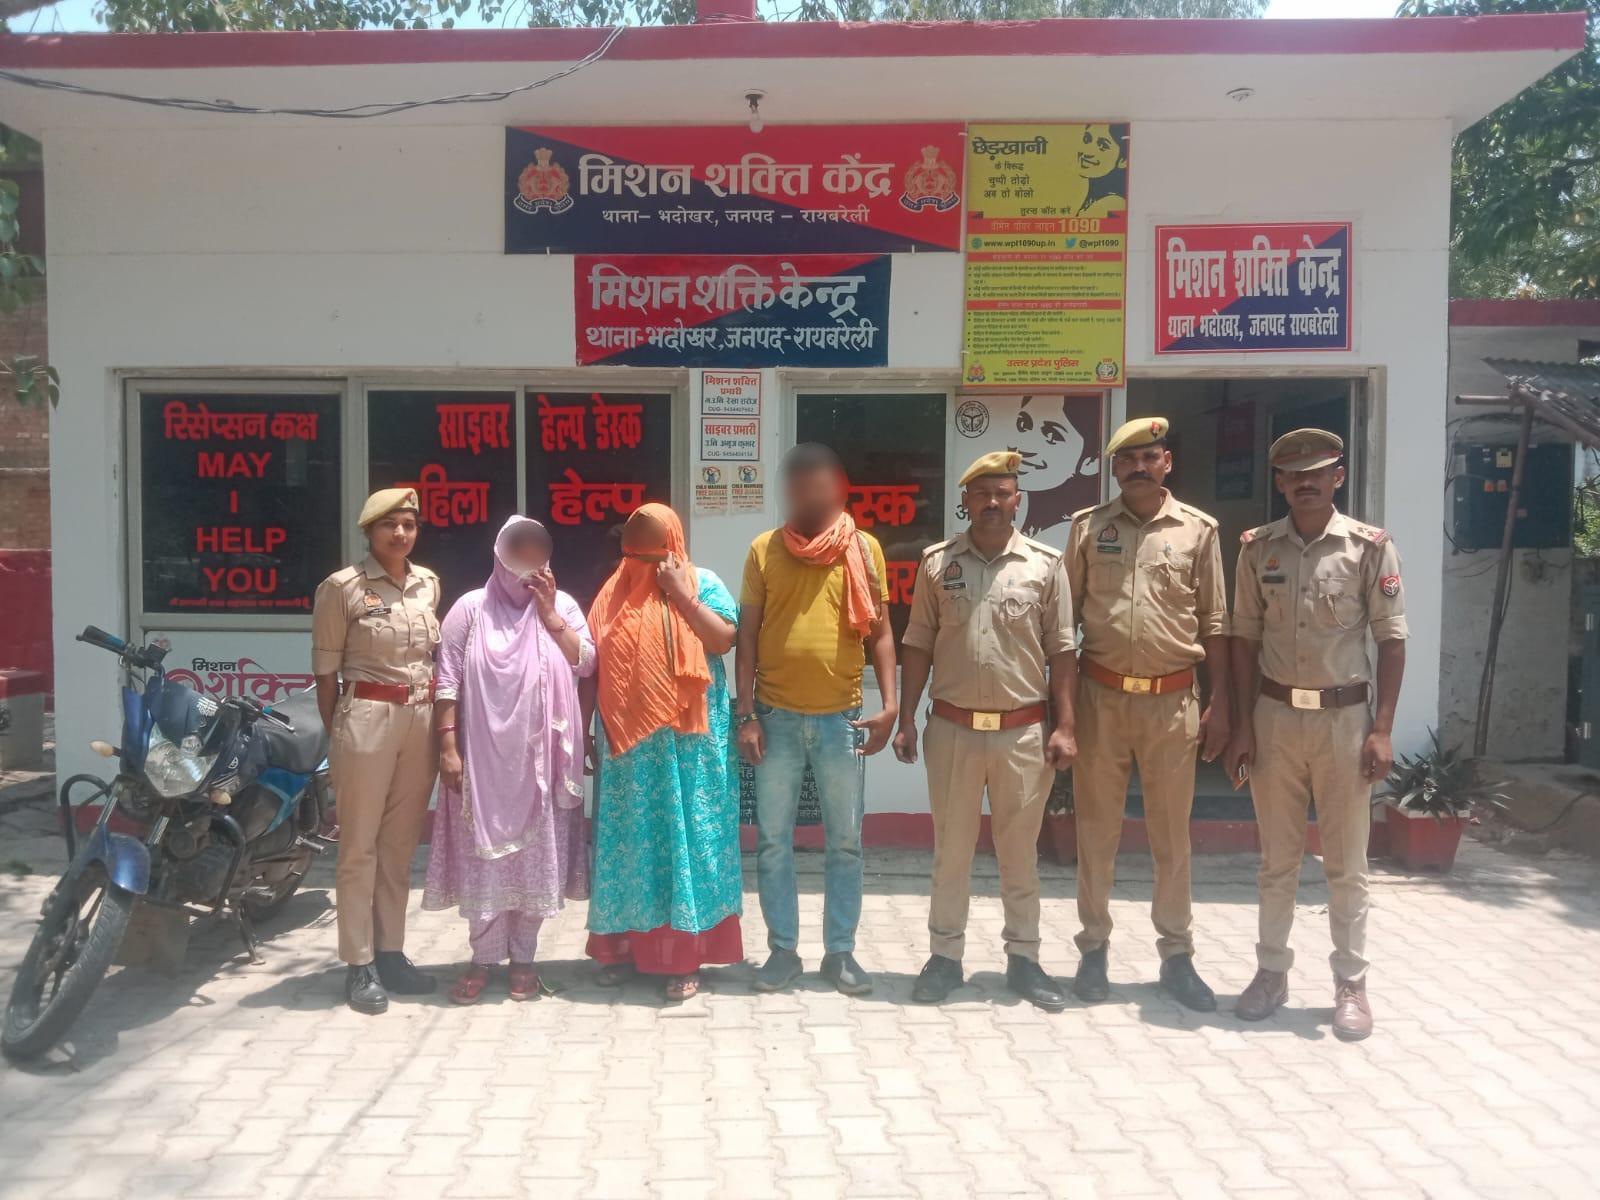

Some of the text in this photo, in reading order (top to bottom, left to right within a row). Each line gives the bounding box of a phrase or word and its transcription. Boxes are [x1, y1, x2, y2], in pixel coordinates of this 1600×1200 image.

[972, 136, 1048, 160] छेड़खानी
[579, 151, 895, 198] मिशन शक्ति केंद्र
[658, 205, 719, 227] भदोखर,
[725, 209, 775, 224] जनपद
[800, 205, 870, 224] रायबरेली
[1058, 219, 1100, 233] 1090
[1166, 233, 1341, 299] मिशन शक्ति केन्द्र
[588, 262, 866, 318] मिशन शक्ति केन्द्र
[1168, 306, 1339, 342] थाना भदोखर, जनपद रायबरेली
[1053, 357, 1079, 370] पुलिस
[704, 375, 731, 385] मिशन
[270, 412, 319, 441] कक्ष
[436, 392, 643, 455] साइबर हेल्प डेस्क
[704, 424, 731, 436] साइबर
[197, 452, 271, 478] MAY
[229, 490, 237, 513] I
[394, 464, 489, 527] हिला
[549, 467, 646, 525] हेल्प
[196, 527, 287, 553] HELP
[203, 567, 277, 593] YOU
[192, 657, 237, 672] मिशन
